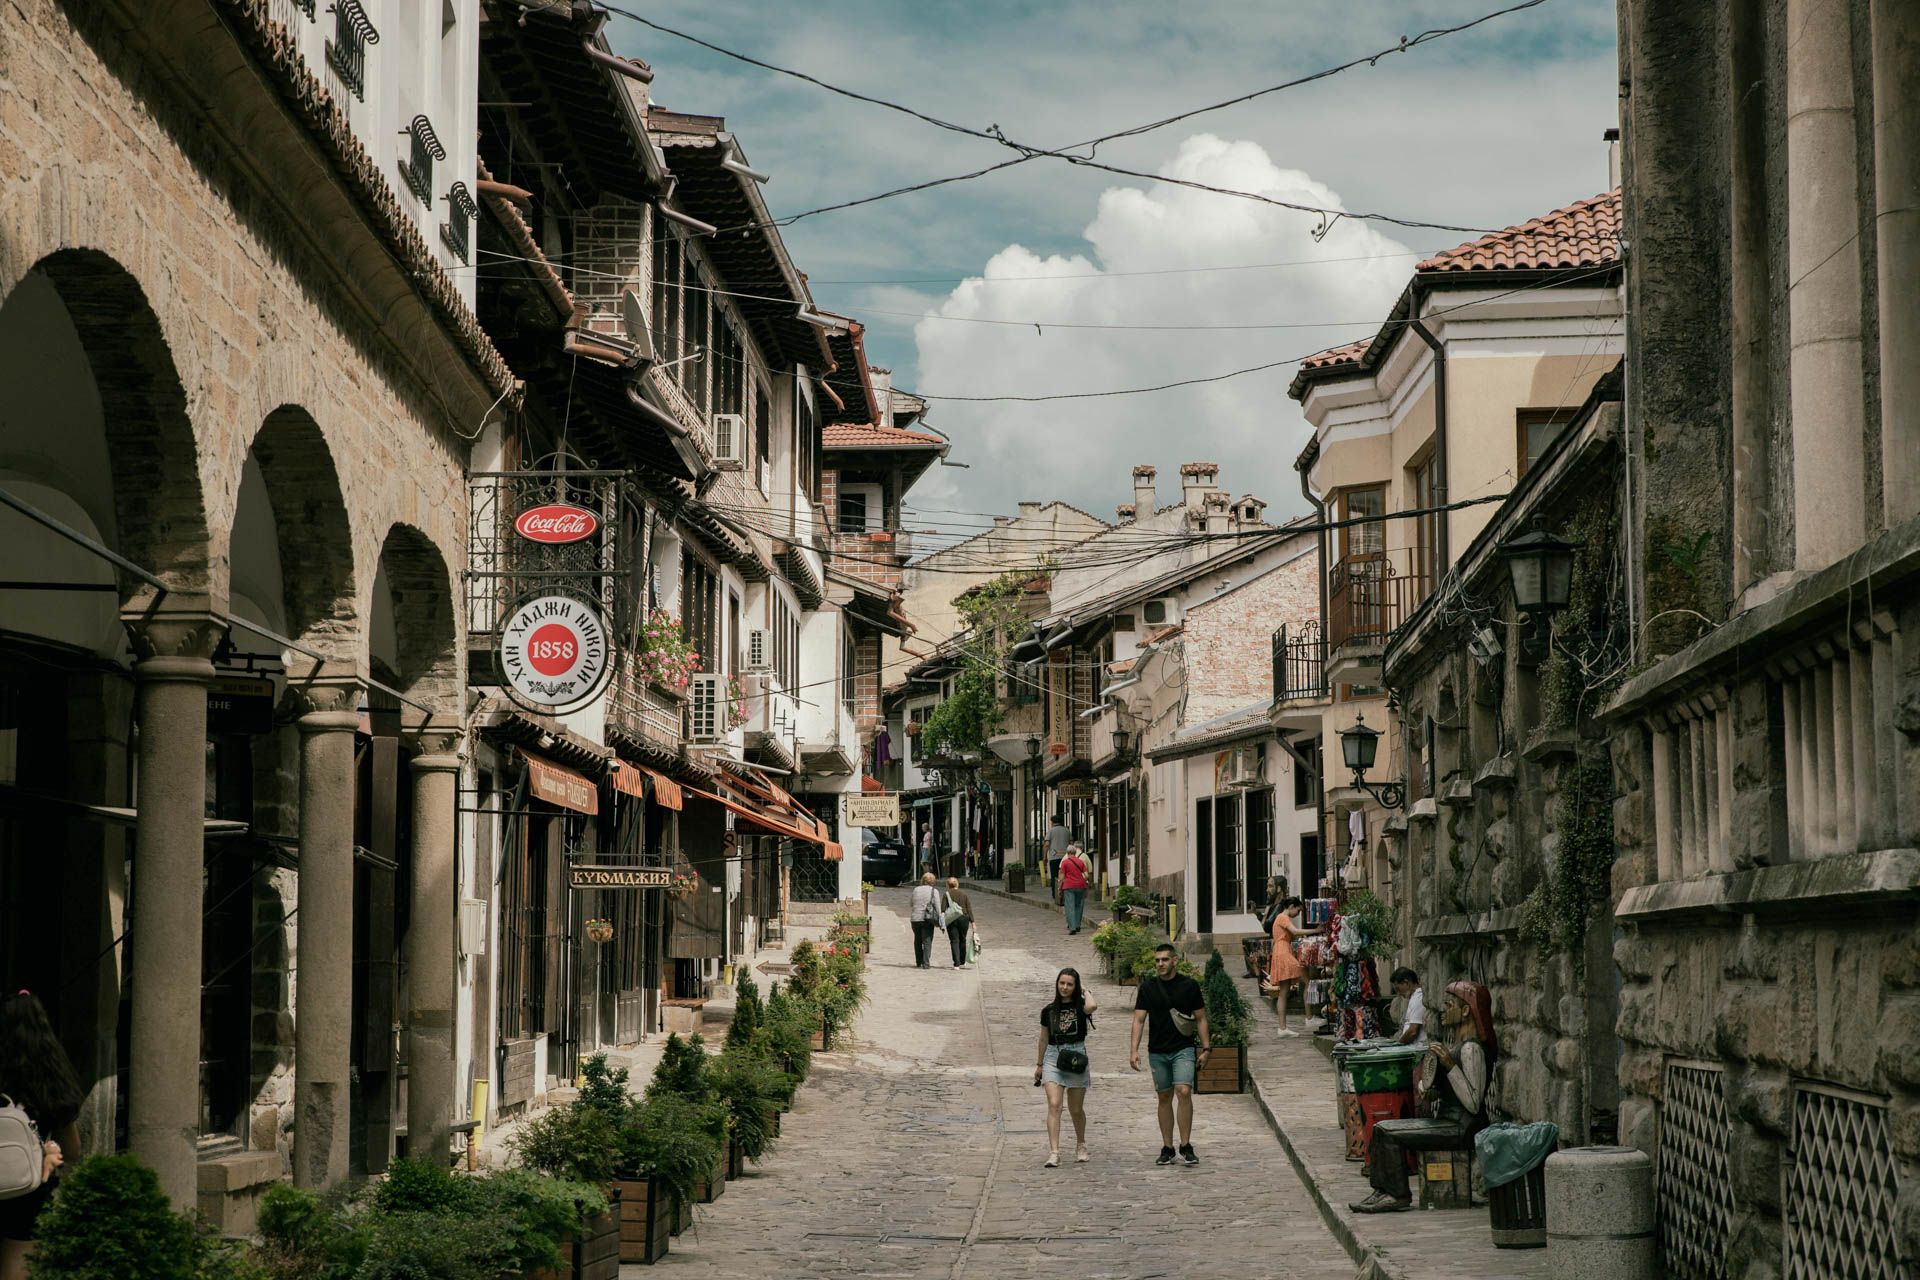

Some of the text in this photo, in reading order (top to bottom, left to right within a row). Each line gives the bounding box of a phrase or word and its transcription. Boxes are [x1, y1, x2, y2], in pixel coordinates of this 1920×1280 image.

[523, 514, 589, 533] Coca-Cola
[505, 601, 601, 684] ХАН ХАДЖИ НИКОЛИ
[532, 640, 574, 659] 1858
[573, 871, 670, 886] КУЮМДЖИЯ
